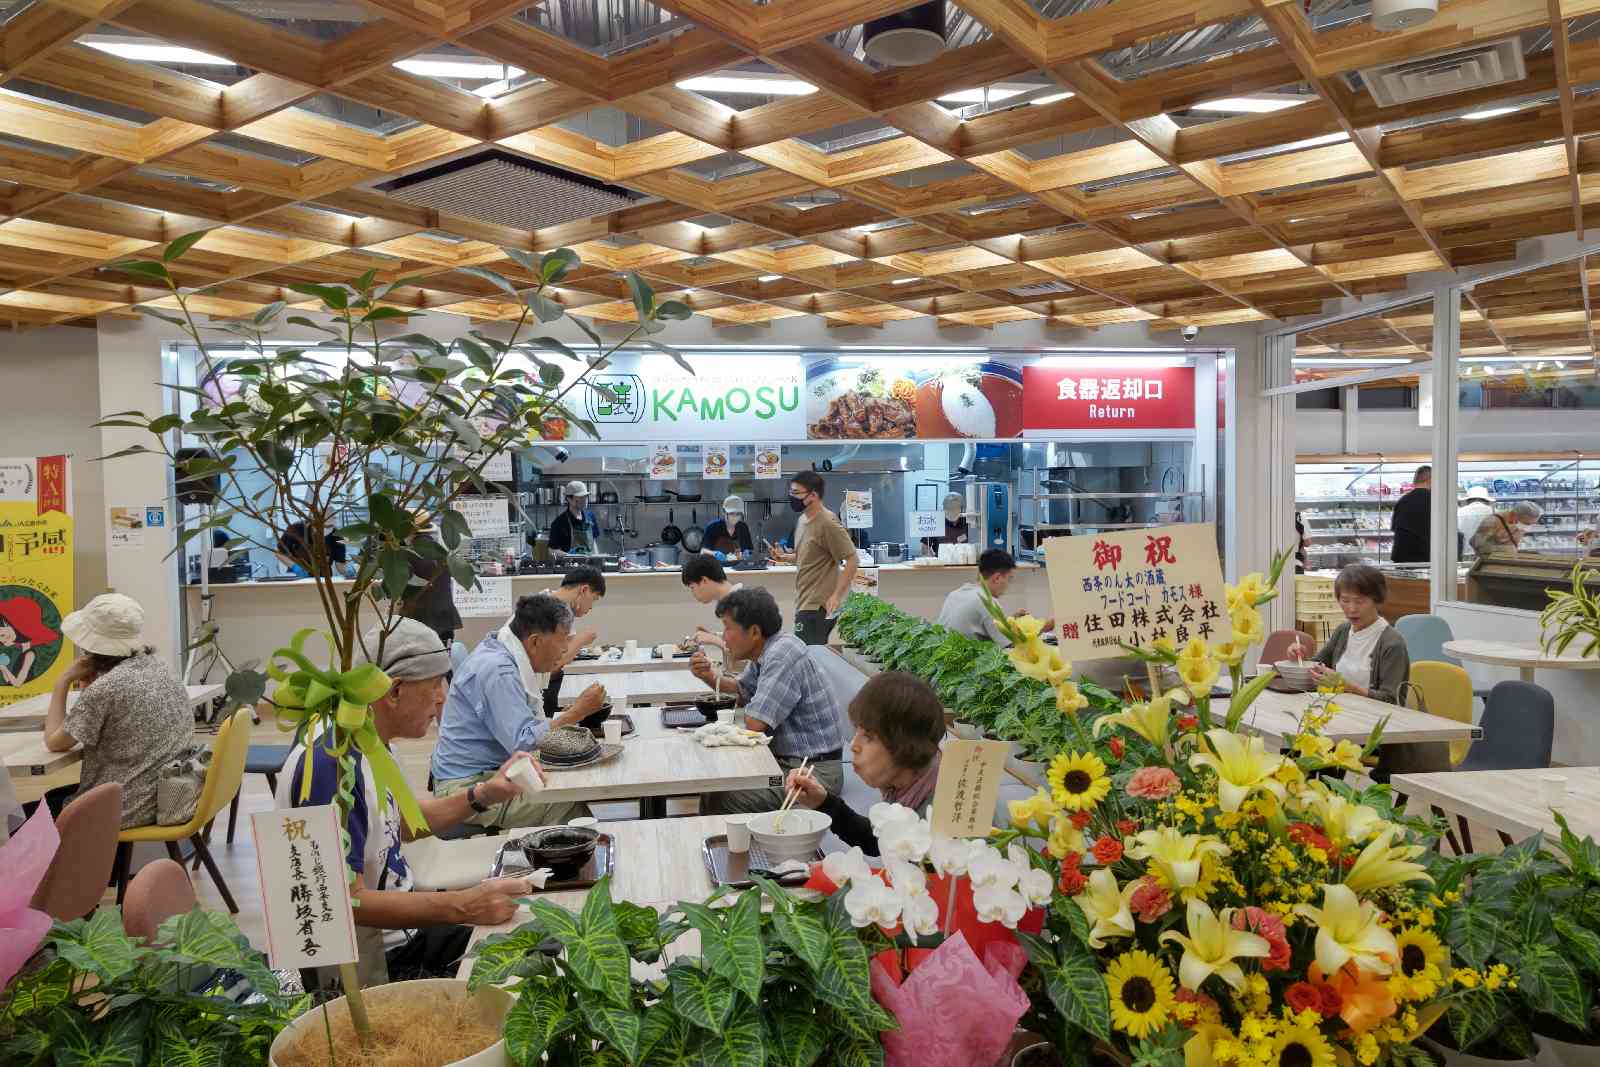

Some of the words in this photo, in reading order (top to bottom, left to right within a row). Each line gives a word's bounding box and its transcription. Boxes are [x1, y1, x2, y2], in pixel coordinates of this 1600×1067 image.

[1056, 377, 1163, 401] 食器返却口
[652, 386, 799, 422] KAMOSU
[1089, 404, 1135, 418] Return
[1091, 535, 1177, 571] 御祝
[1100, 589, 1151, 610] フードコート
[1084, 600, 1221, 633] 住田株式会社
[281, 816, 312, 842] 祝
